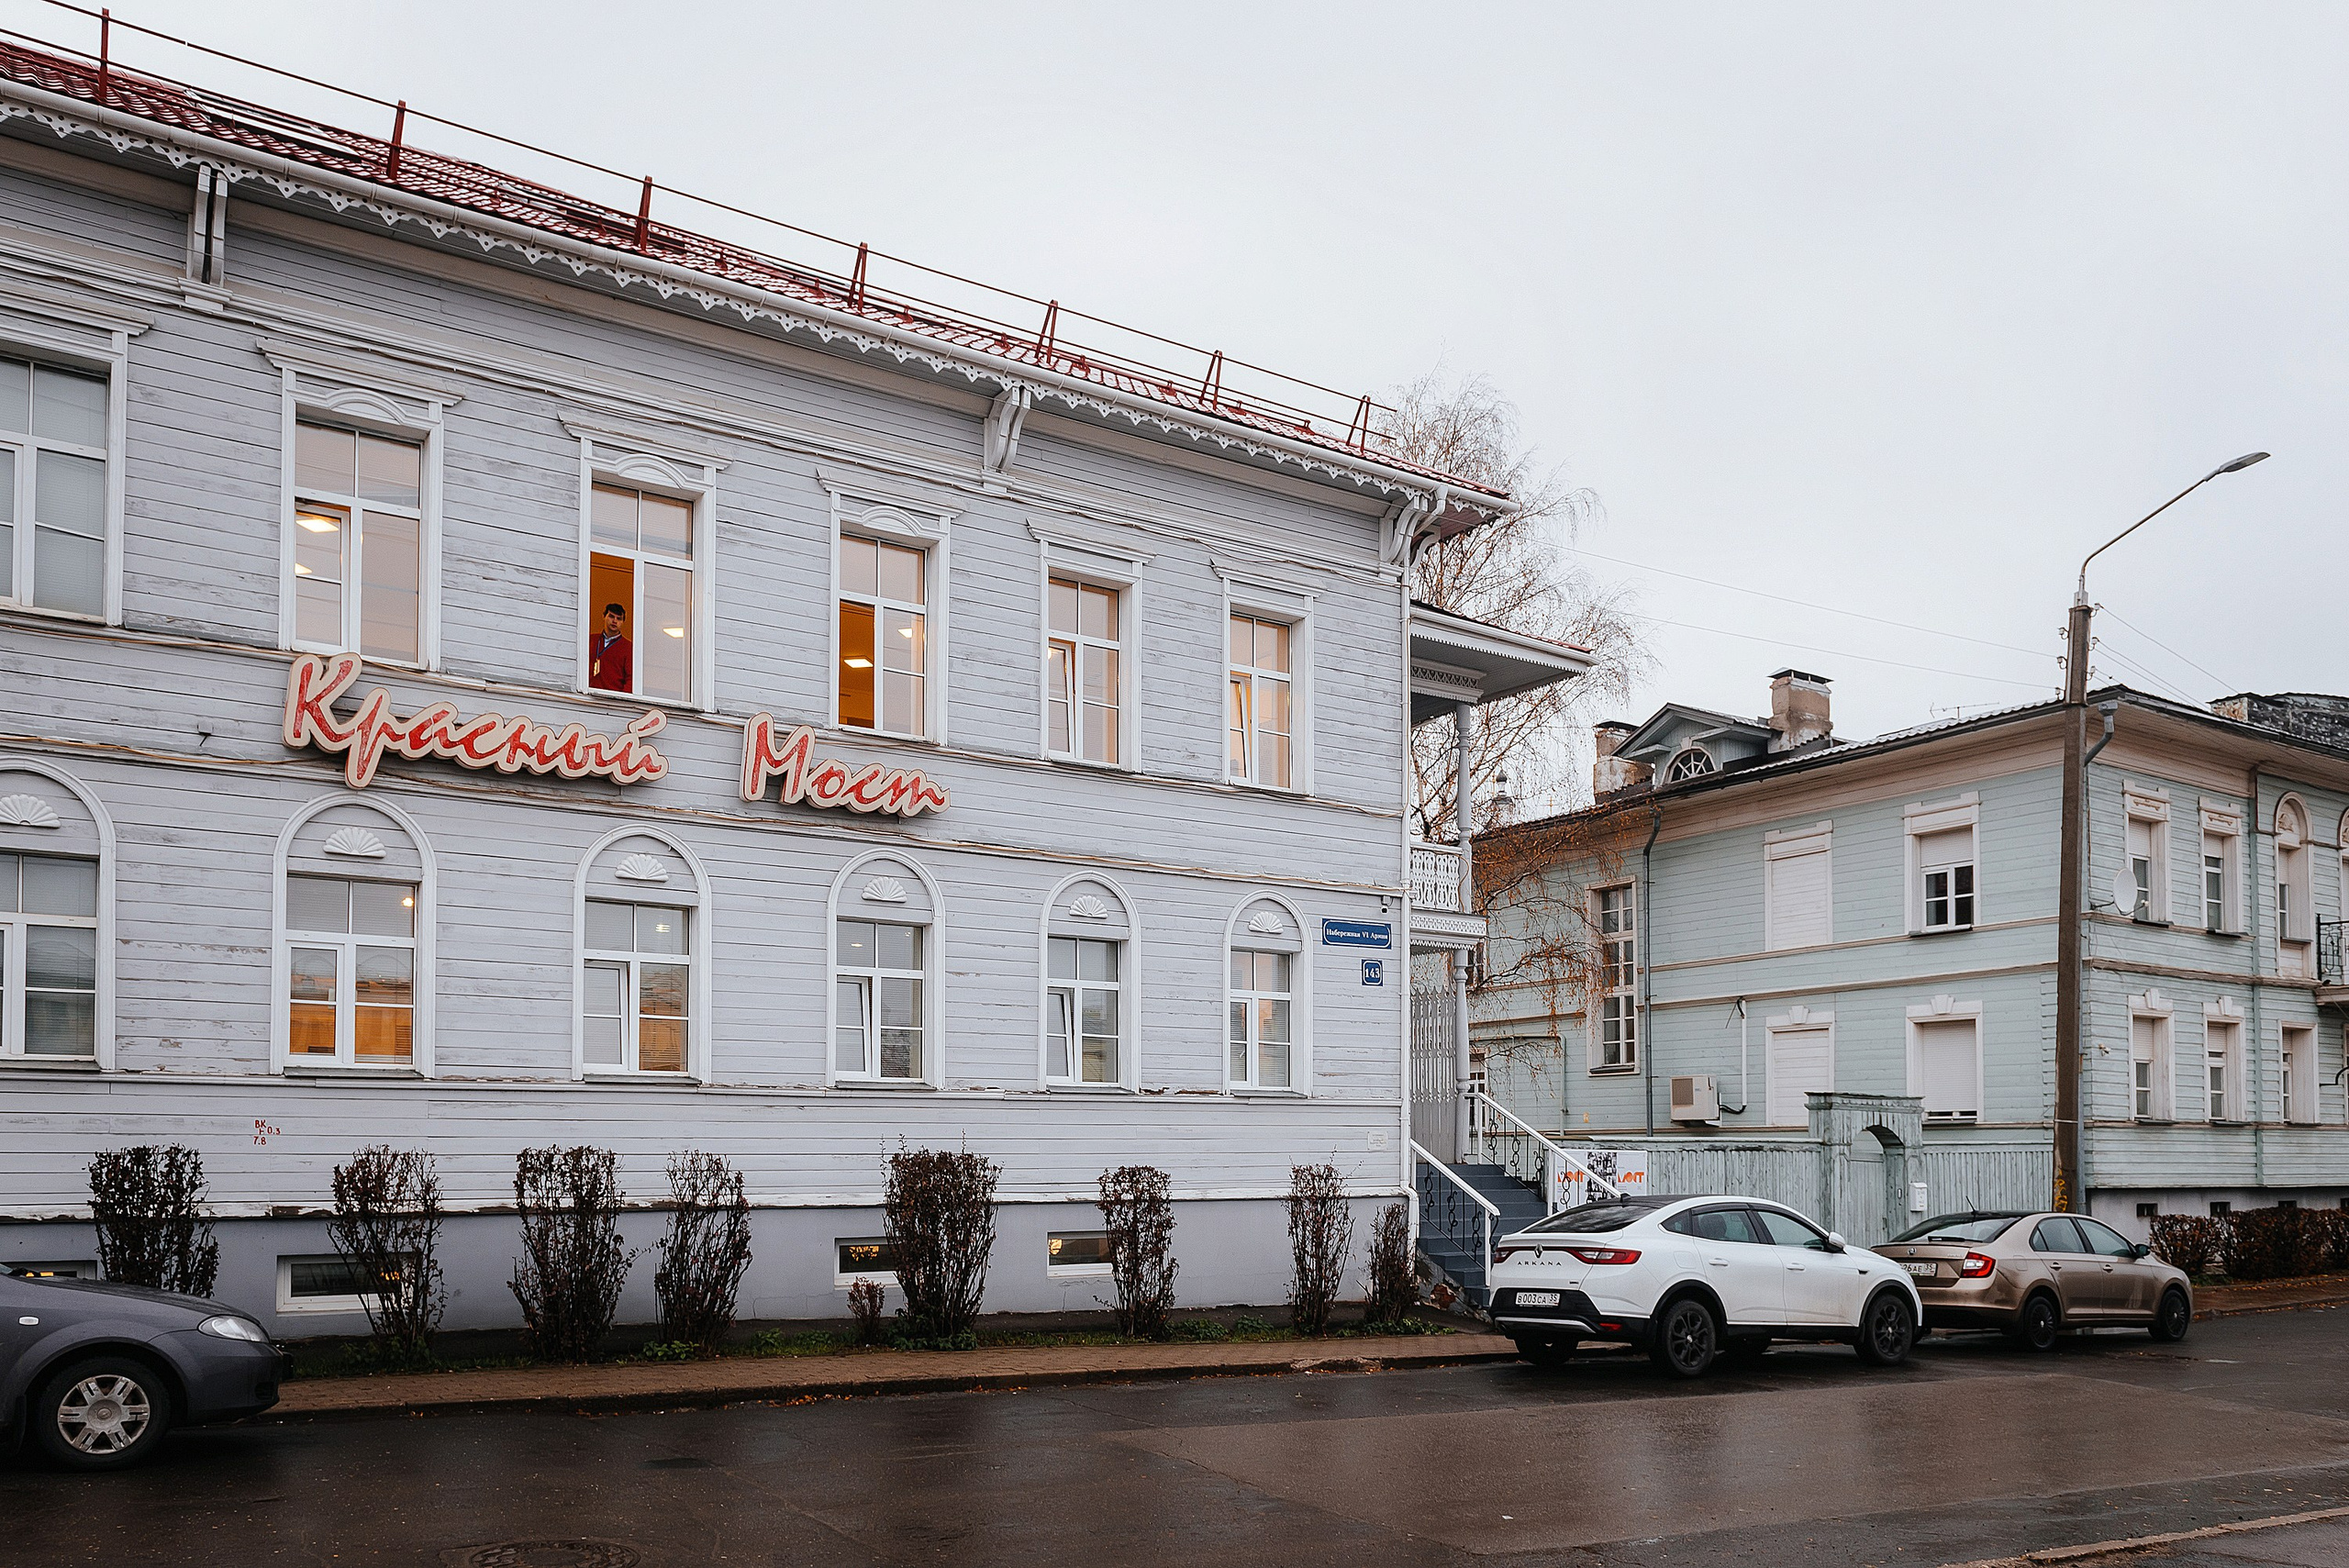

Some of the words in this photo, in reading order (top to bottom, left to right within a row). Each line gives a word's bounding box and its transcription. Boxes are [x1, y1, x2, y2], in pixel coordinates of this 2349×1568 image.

[286, 653, 669, 787] Красный
[740, 713, 951, 816] Мост
[1326, 929, 1361, 938] Набережная
[1364, 968, 1380, 978] 143
[253, 1136, 267, 1145] 7.8
